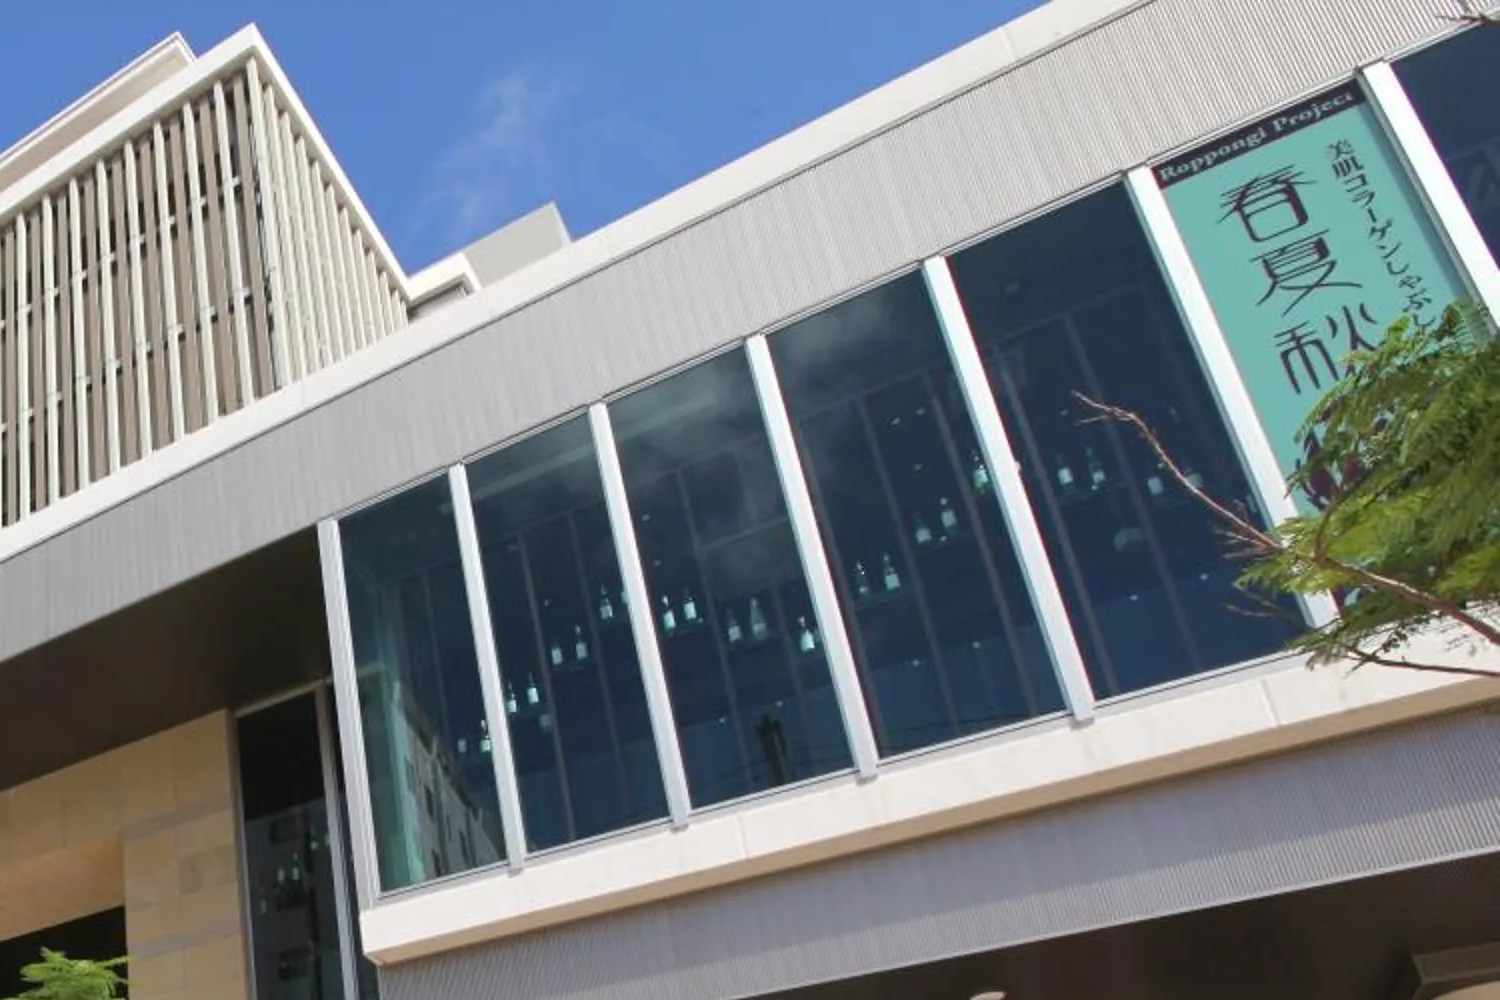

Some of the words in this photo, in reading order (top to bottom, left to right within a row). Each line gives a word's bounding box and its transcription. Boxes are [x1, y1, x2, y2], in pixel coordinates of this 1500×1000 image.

[1159, 127, 1269, 181] Roppongi
[1272, 93, 1355, 133] Project
[1217, 164, 1380, 395] 春夏秋
